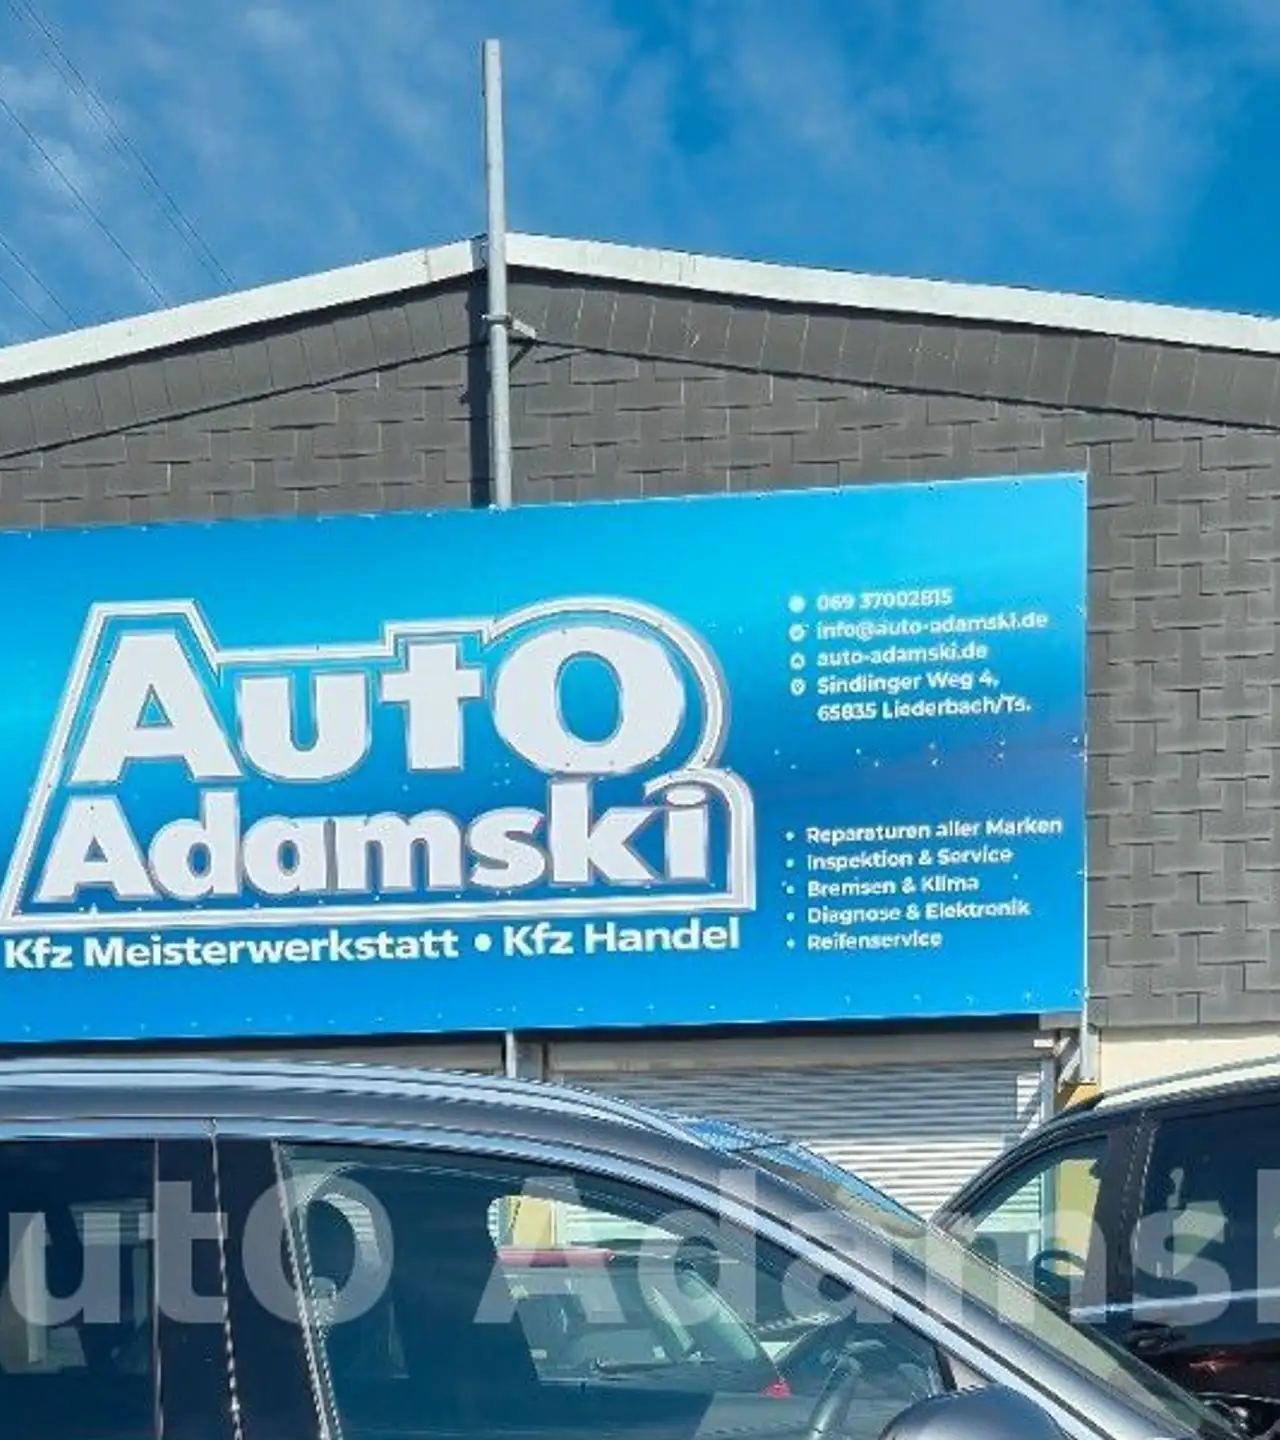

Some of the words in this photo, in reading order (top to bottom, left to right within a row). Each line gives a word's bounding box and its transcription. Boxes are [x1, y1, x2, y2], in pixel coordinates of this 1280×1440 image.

[816, 611, 1048, 641] info@auto-adamski.de
[816, 643, 988, 667] auto-adamski.de
[816, 673, 922, 696] Sindlinger
[926, 669, 972, 691] Weg
[978, 668, 1000, 687] 4,
[882, 695, 1031, 719] Liederbach/Ts.
[32, 775, 711, 903] Adamski
[806, 825, 932, 846] Reparaturen
[935, 821, 980, 839] aller
[985, 817, 1062, 835] Marken
[807, 849, 913, 872] Inspektion
[918, 849, 932, 865] &
[937, 846, 1014, 864] Service
[807, 879, 896, 898] Bremsen
[901, 877, 916, 894] &
[922, 875, 979, 893] Klima
[807, 906, 901, 926] Diagnose
[906, 904, 920, 920] &
[925, 898, 1031, 920] Elektronik
[3, 937, 73, 968] Kfz
[84, 930, 459, 967] Meisterwerkstatt
[503, 924, 573, 957] Kfz
[584, 917, 740, 953] Handel
[807, 929, 942, 951] Reifenservice
